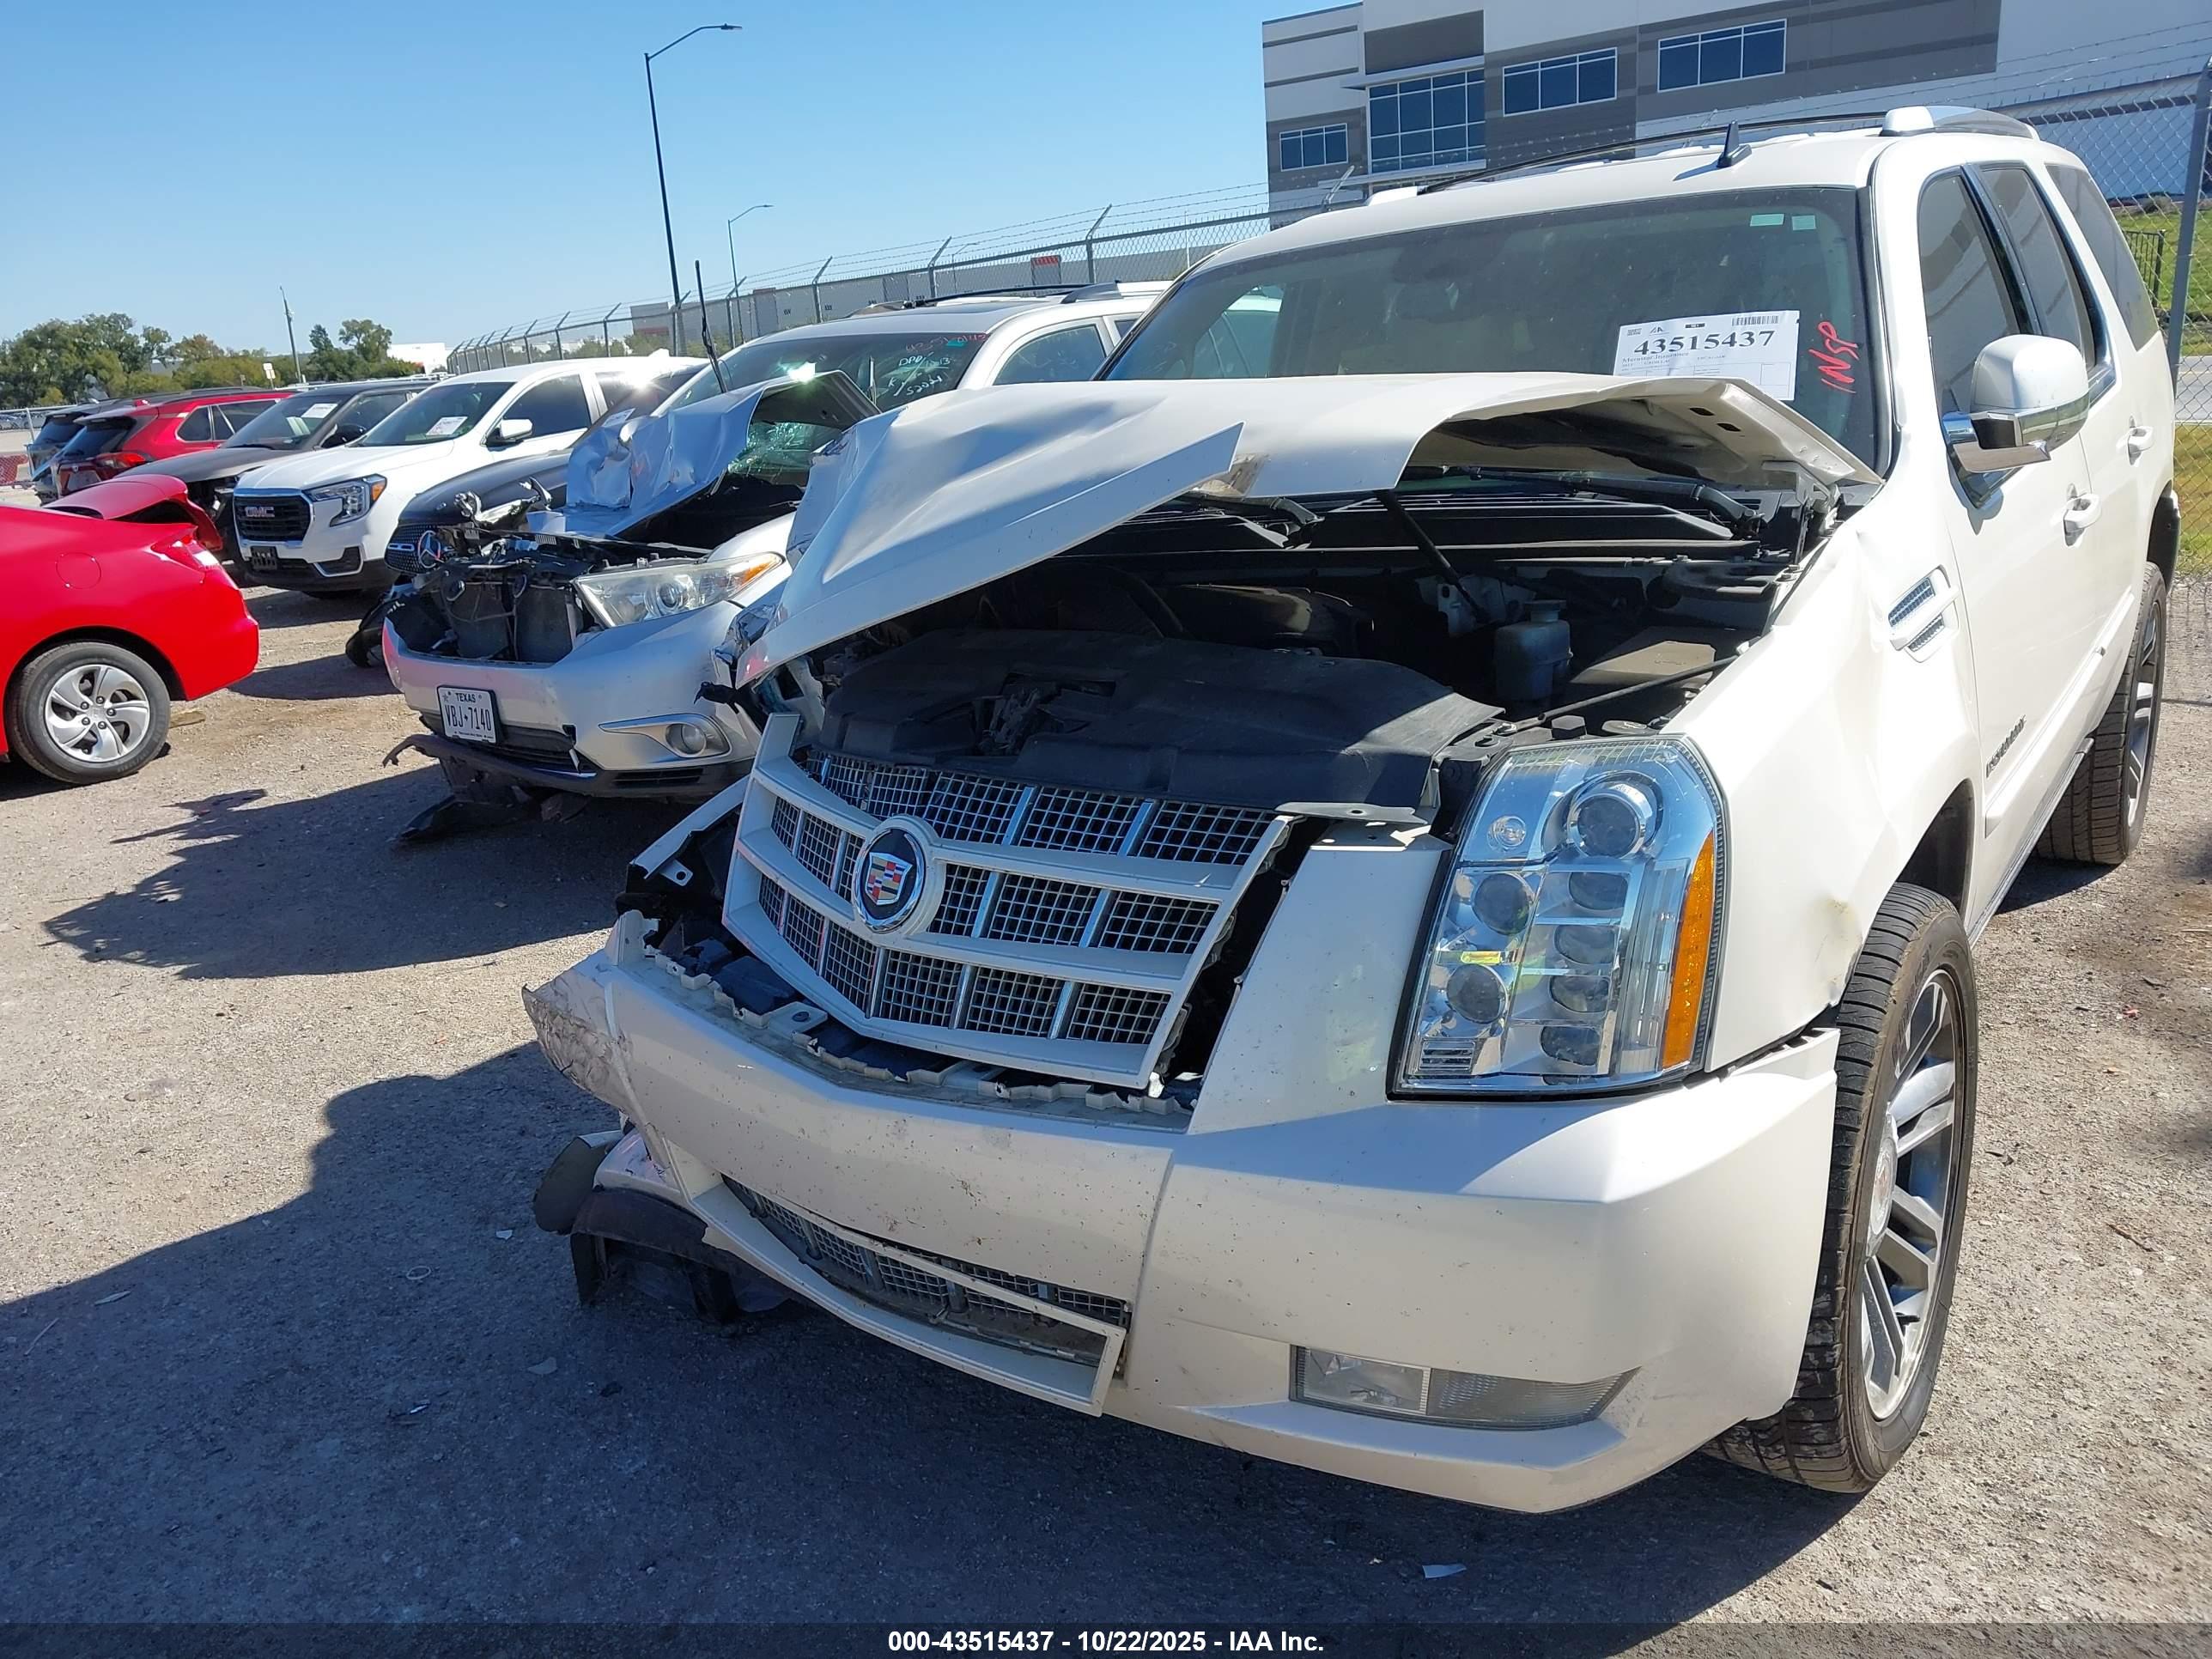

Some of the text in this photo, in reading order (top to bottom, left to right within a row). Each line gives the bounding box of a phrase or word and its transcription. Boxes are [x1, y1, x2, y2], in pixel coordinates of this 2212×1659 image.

[1634, 330, 1776, 356] 43515437
[245, 506, 276, 518] GMC
[455, 692, 477, 702] TEXAS
